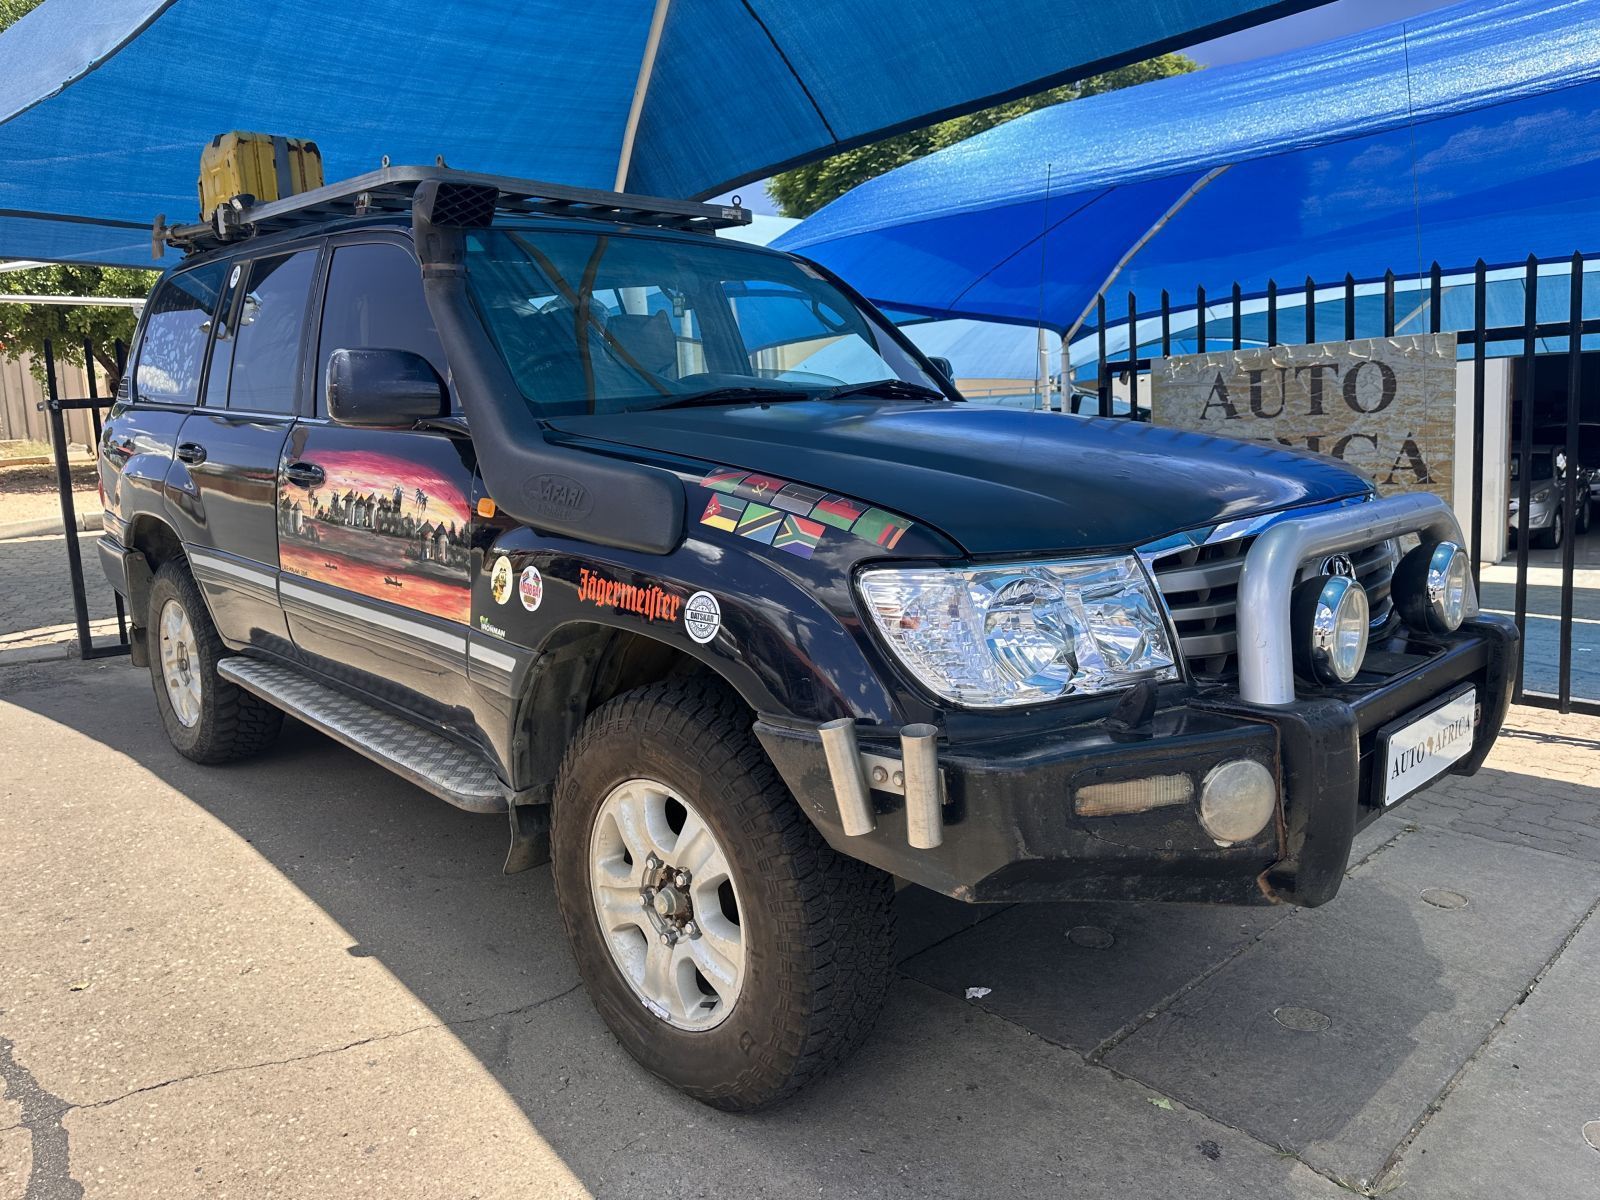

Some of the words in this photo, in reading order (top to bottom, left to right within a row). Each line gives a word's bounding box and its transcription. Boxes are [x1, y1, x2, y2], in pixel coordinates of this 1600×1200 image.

[1200, 360, 1397, 420] AUTO
[529, 477, 584, 508] SAFARI
[1391, 741, 1426, 780] AUTO
[1434, 713, 1471, 753] AFRICA
